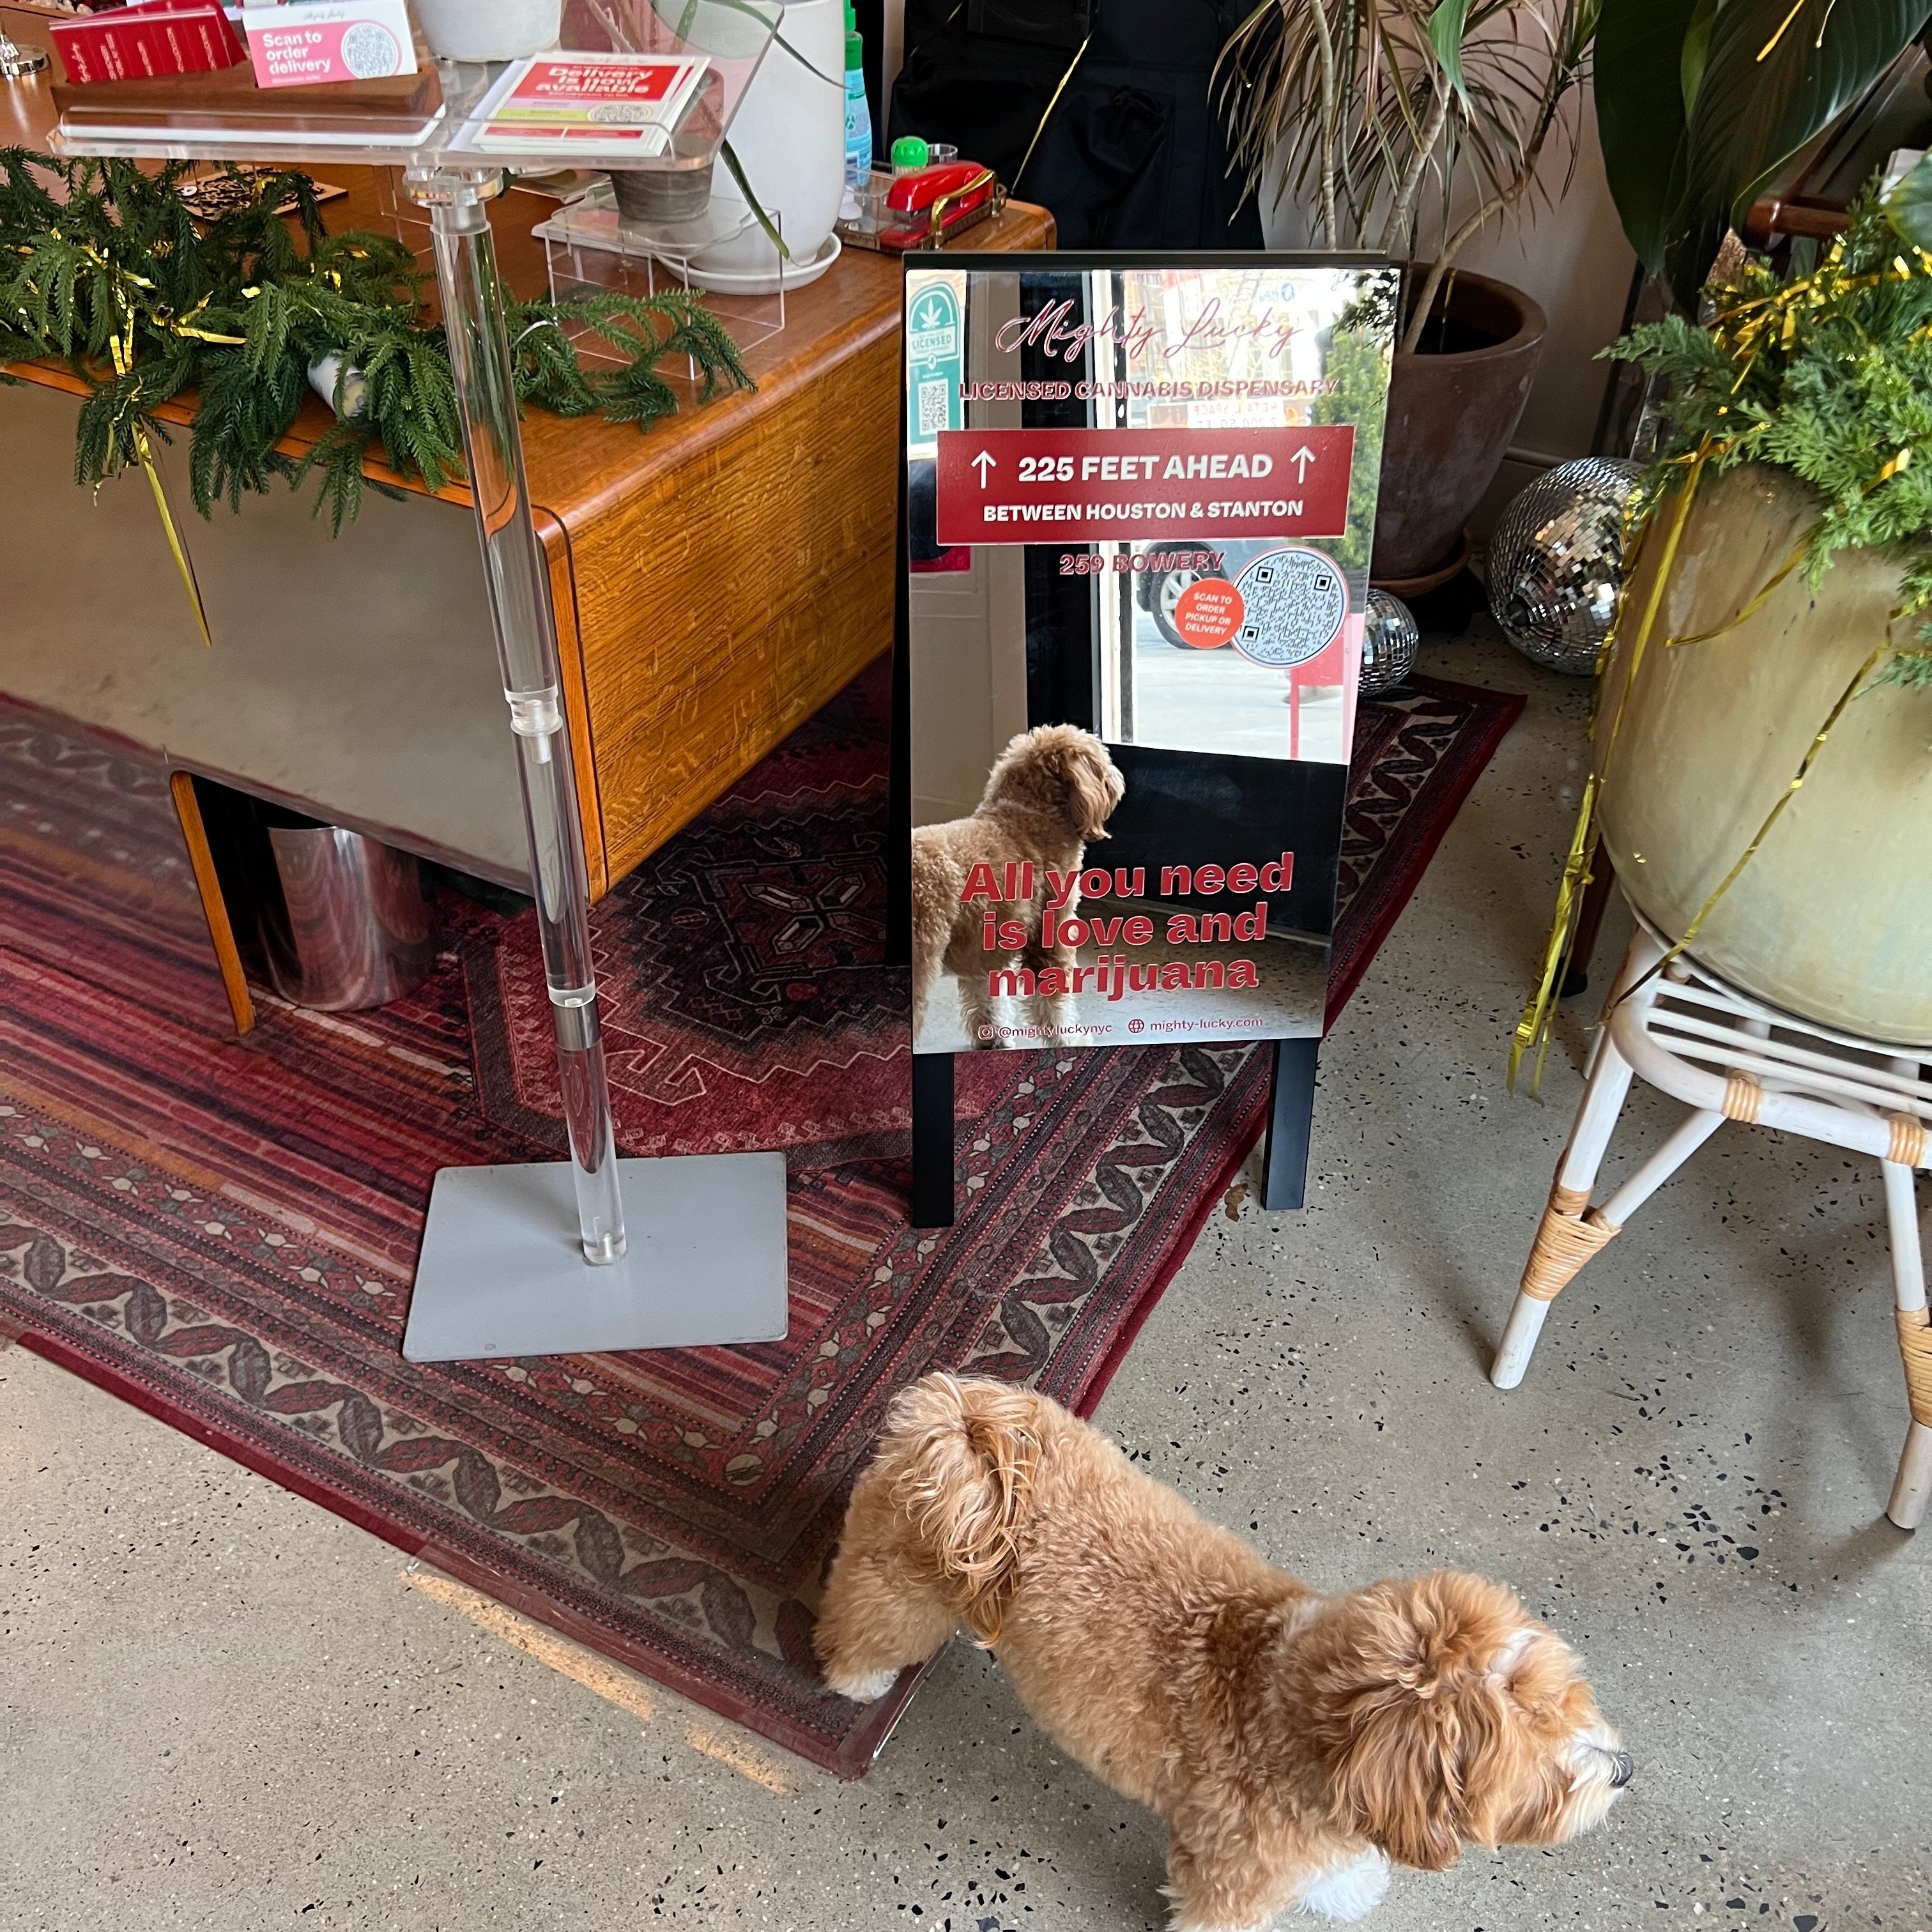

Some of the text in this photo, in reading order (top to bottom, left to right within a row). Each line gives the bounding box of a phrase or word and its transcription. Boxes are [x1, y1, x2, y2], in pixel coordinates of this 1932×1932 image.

[263, 31, 322, 47] Scan to
[266, 46, 308, 61] order
[269, 58, 331, 75] delivery
[548, 67, 653, 82] Delivery
[536, 82, 649, 93] available
[558, 76, 639, 86] is now
[995, 297, 1305, 362] Mighty Lucky
[912, 335, 951, 349] LICENSED
[959, 378, 1339, 401] LICENSED CANNABIS DISPENSARY
[1018, 454, 1273, 482] 225 FEET AHEAD
[983, 500, 1303, 523] BETWEEN HOUSTON & STANTON
[1060, 552, 1225, 575] 259 BOWERY
[1193, 592, 1232, 605] SCAN TO
[1195, 603, 1225, 614] ORDER
[1184, 612, 1232, 625] PICKUP OR
[1184, 622, 1227, 636] DELIVERY
[960, 852, 1294, 910] All you need
[983, 902, 1268, 951] is love and
[989, 954, 1259, 1001] marijuana
[997, 1017, 1263, 1039] @mightyluckynyc mighty-lucky.com
